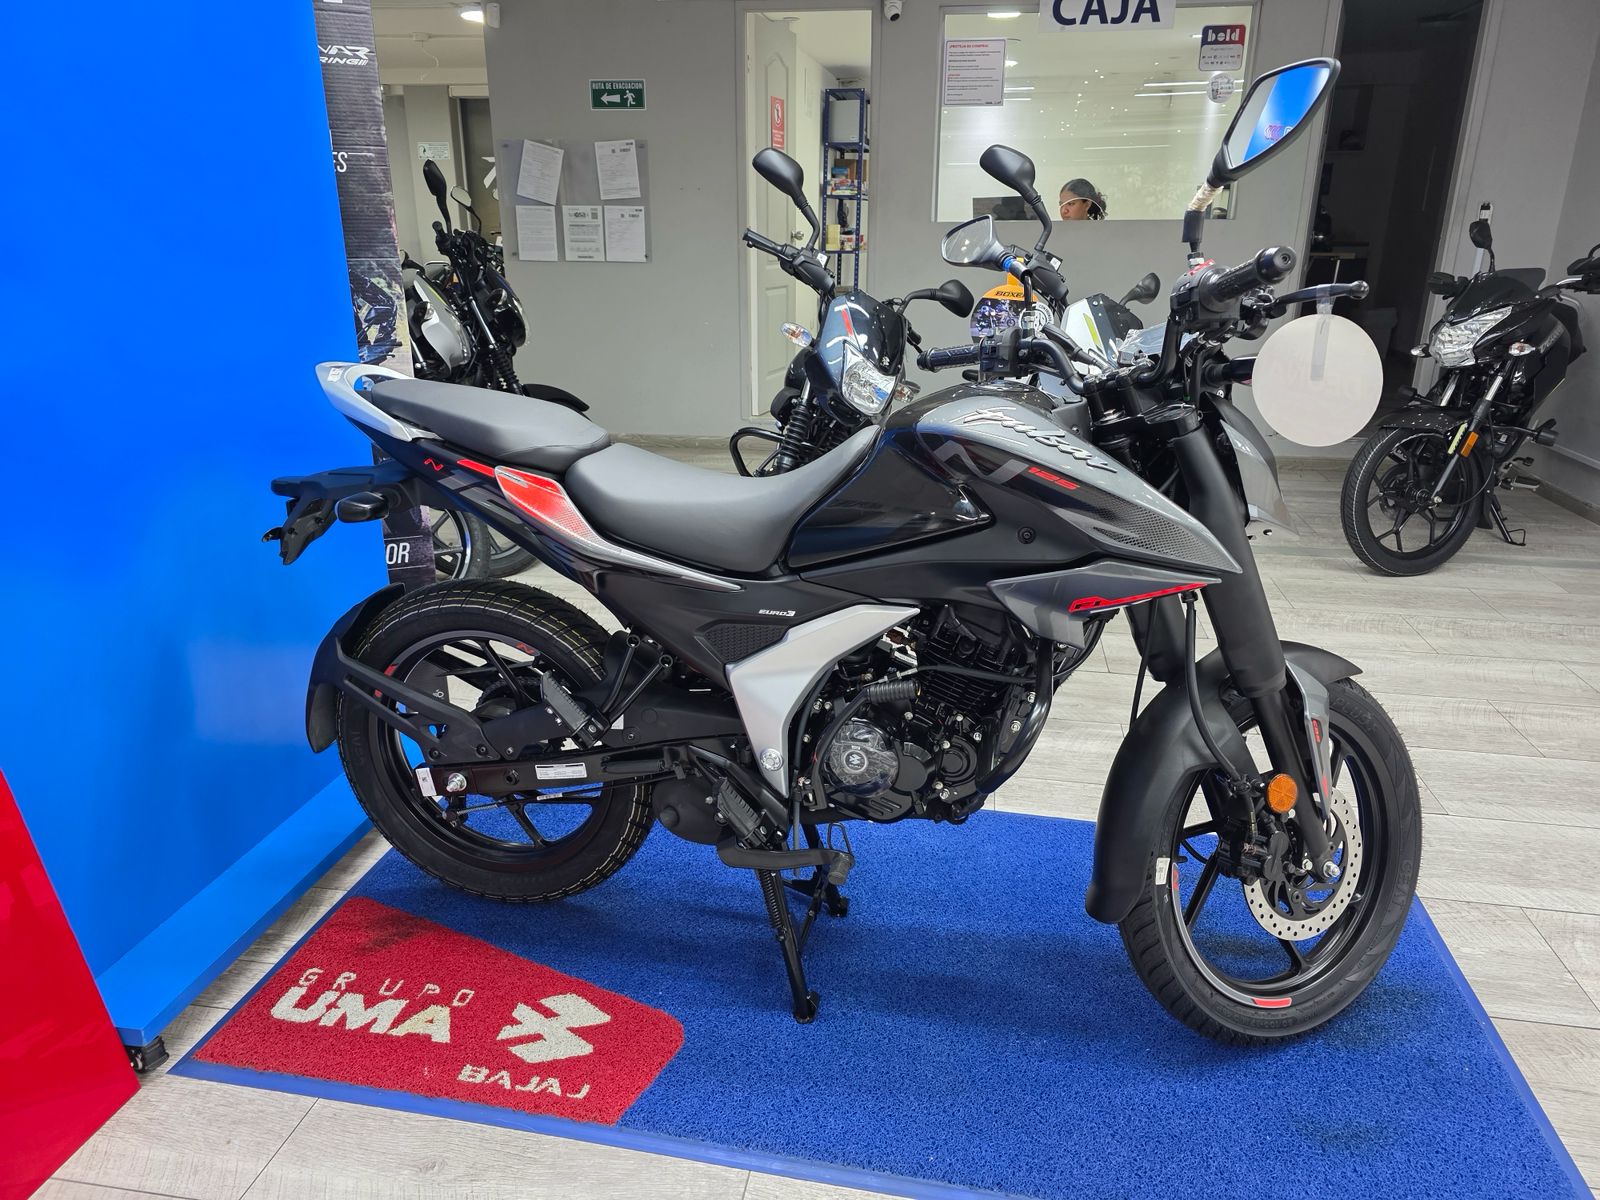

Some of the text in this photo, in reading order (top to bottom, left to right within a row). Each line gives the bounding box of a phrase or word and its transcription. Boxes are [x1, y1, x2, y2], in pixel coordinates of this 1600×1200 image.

[1052, 0, 1160, 25] CAJA
[1207, 28, 1240, 42] bold
[592, 82, 605, 90] RUTA
[606, 82, 612, 90] DE
[1028, 466, 1081, 491] 125
[299, 967, 476, 1007] GRUPO
[270, 986, 452, 1044] UMA
[457, 1063, 591, 1100] BAJAJ
